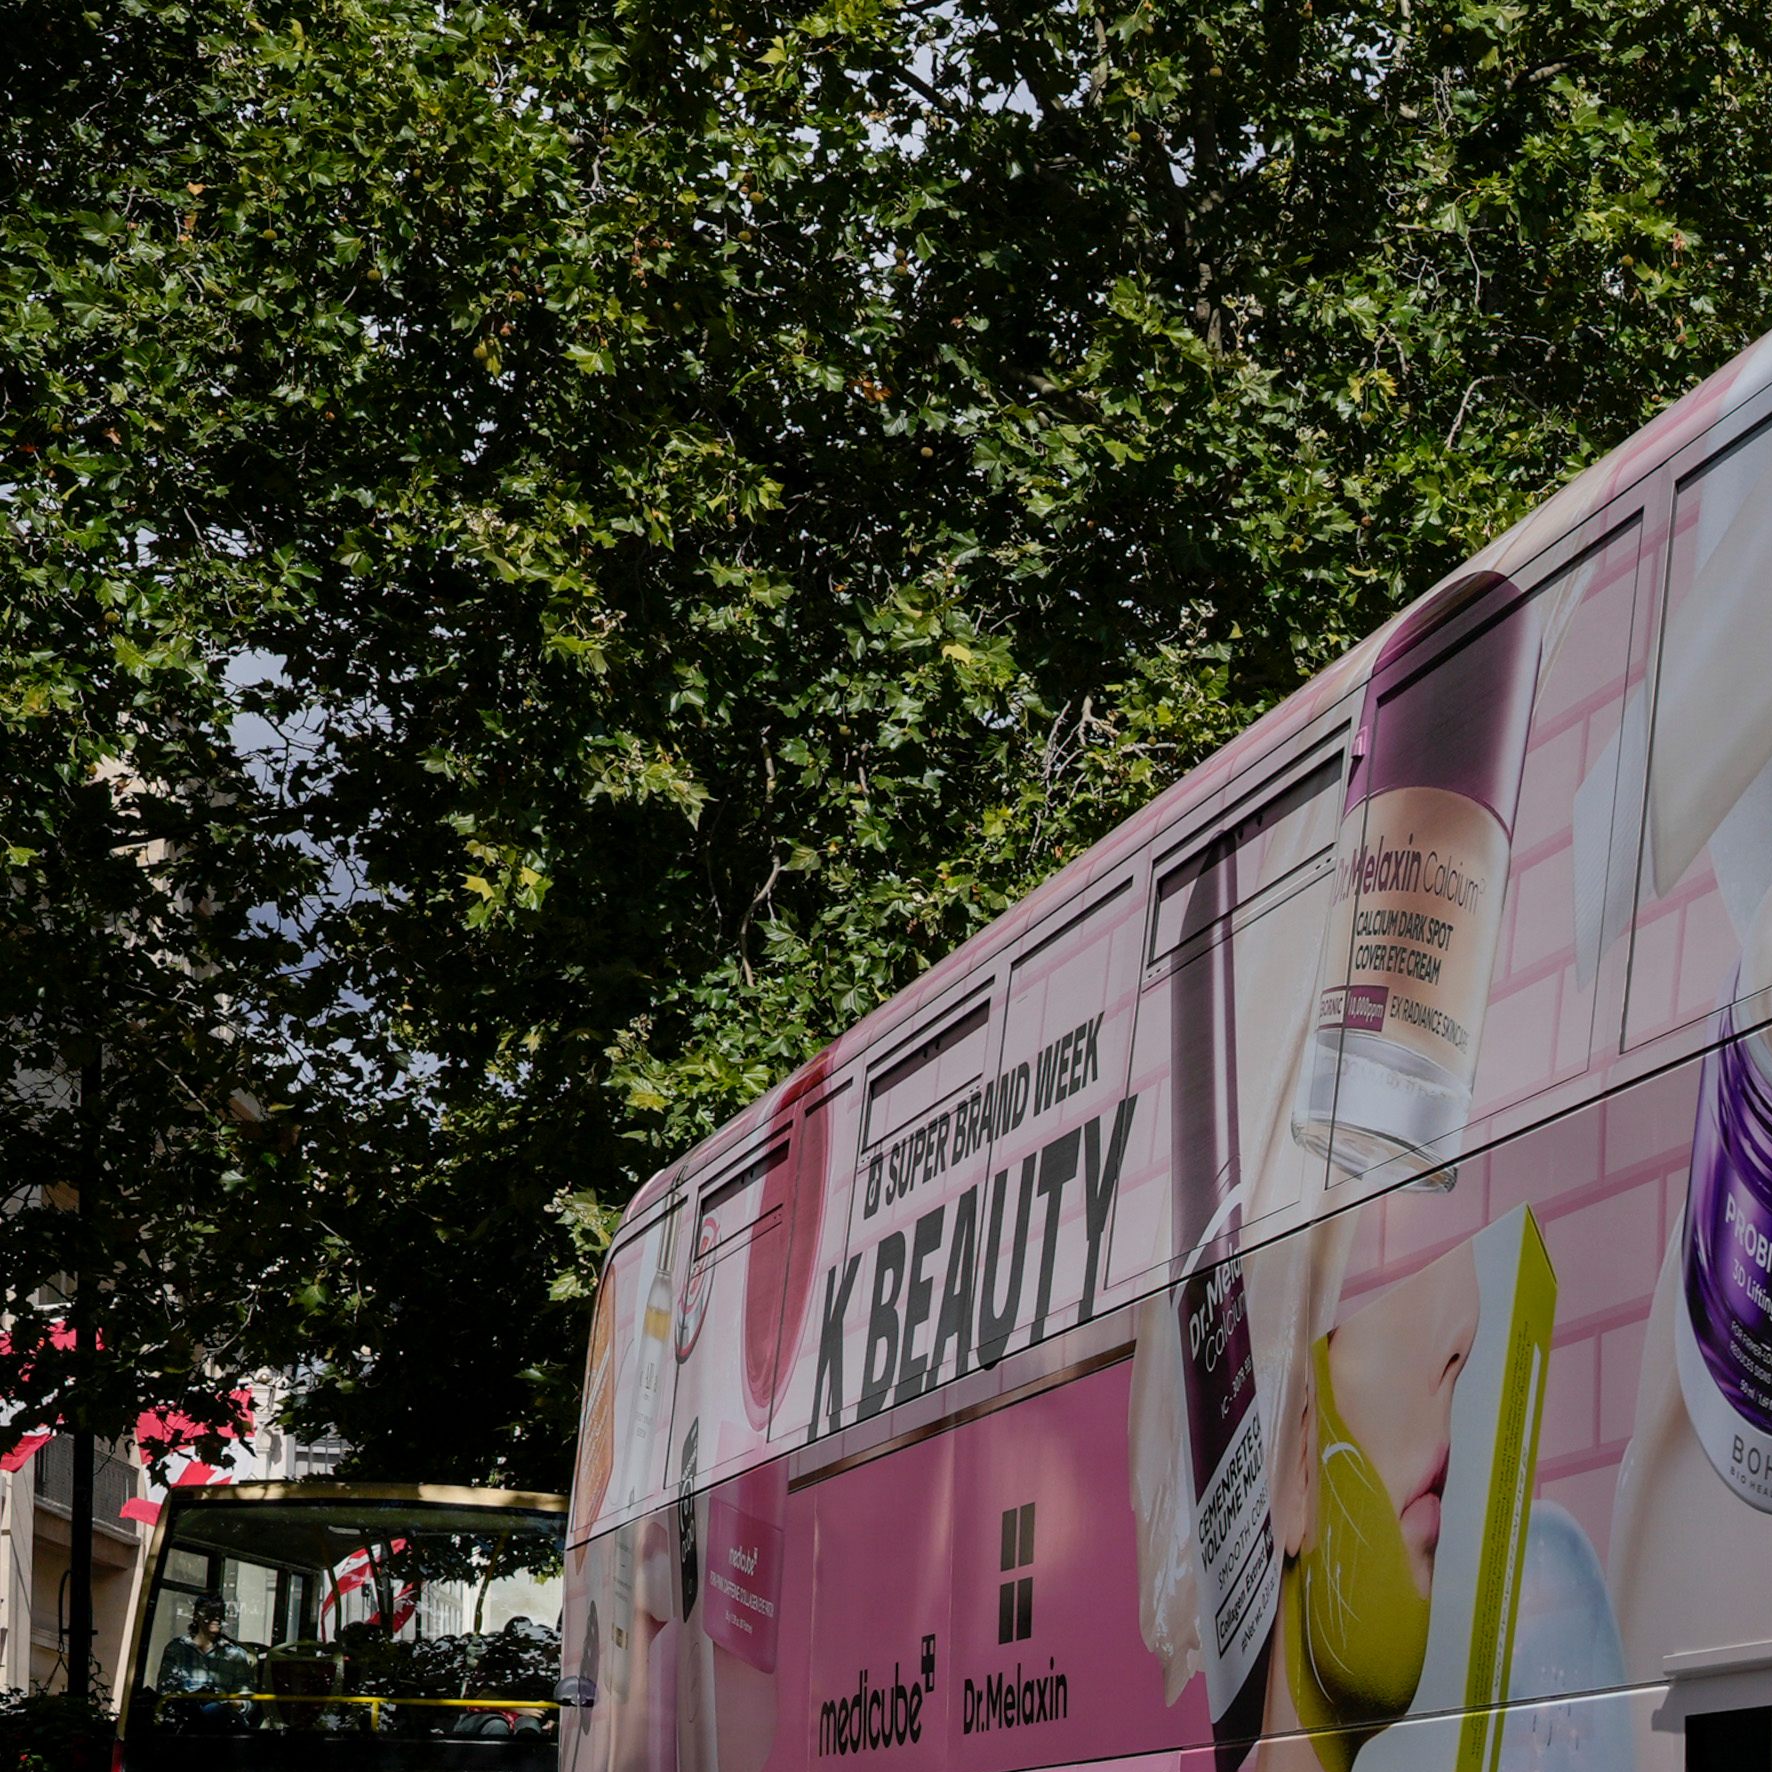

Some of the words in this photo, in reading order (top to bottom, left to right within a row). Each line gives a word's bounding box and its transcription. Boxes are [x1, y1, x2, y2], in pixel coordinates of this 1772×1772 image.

[1355, 909, 1399, 938] CALCIUM
[1398, 911, 1426, 943] DARK
[1426, 918, 1455, 952] SPOT
[1355, 945, 1387, 971] COVER
[1386, 946, 1407, 974] EYE
[1406, 950, 1443, 987] CREAM
[885, 1111, 951, 1208] SUPER
[951, 1062, 1030, 1167] BRAND
[1033, 1011, 1104, 1119] WEEK
[807, 1252, 863, 1443] K
[857, 1095, 1138, 1422] BEAUTY
[1732, 1258, 1746, 1289] 3D
[1198, 1430, 1251, 1544] CEMENRETE
[1729, 1465, 1748, 1487] BIO
[1200, 1491, 1244, 1574] VOLUME
[1216, 1525, 1251, 1593] SMOOTH
[817, 1661, 923, 1759] medicube
[962, 1656, 1069, 1736] Dr.Melaxin
